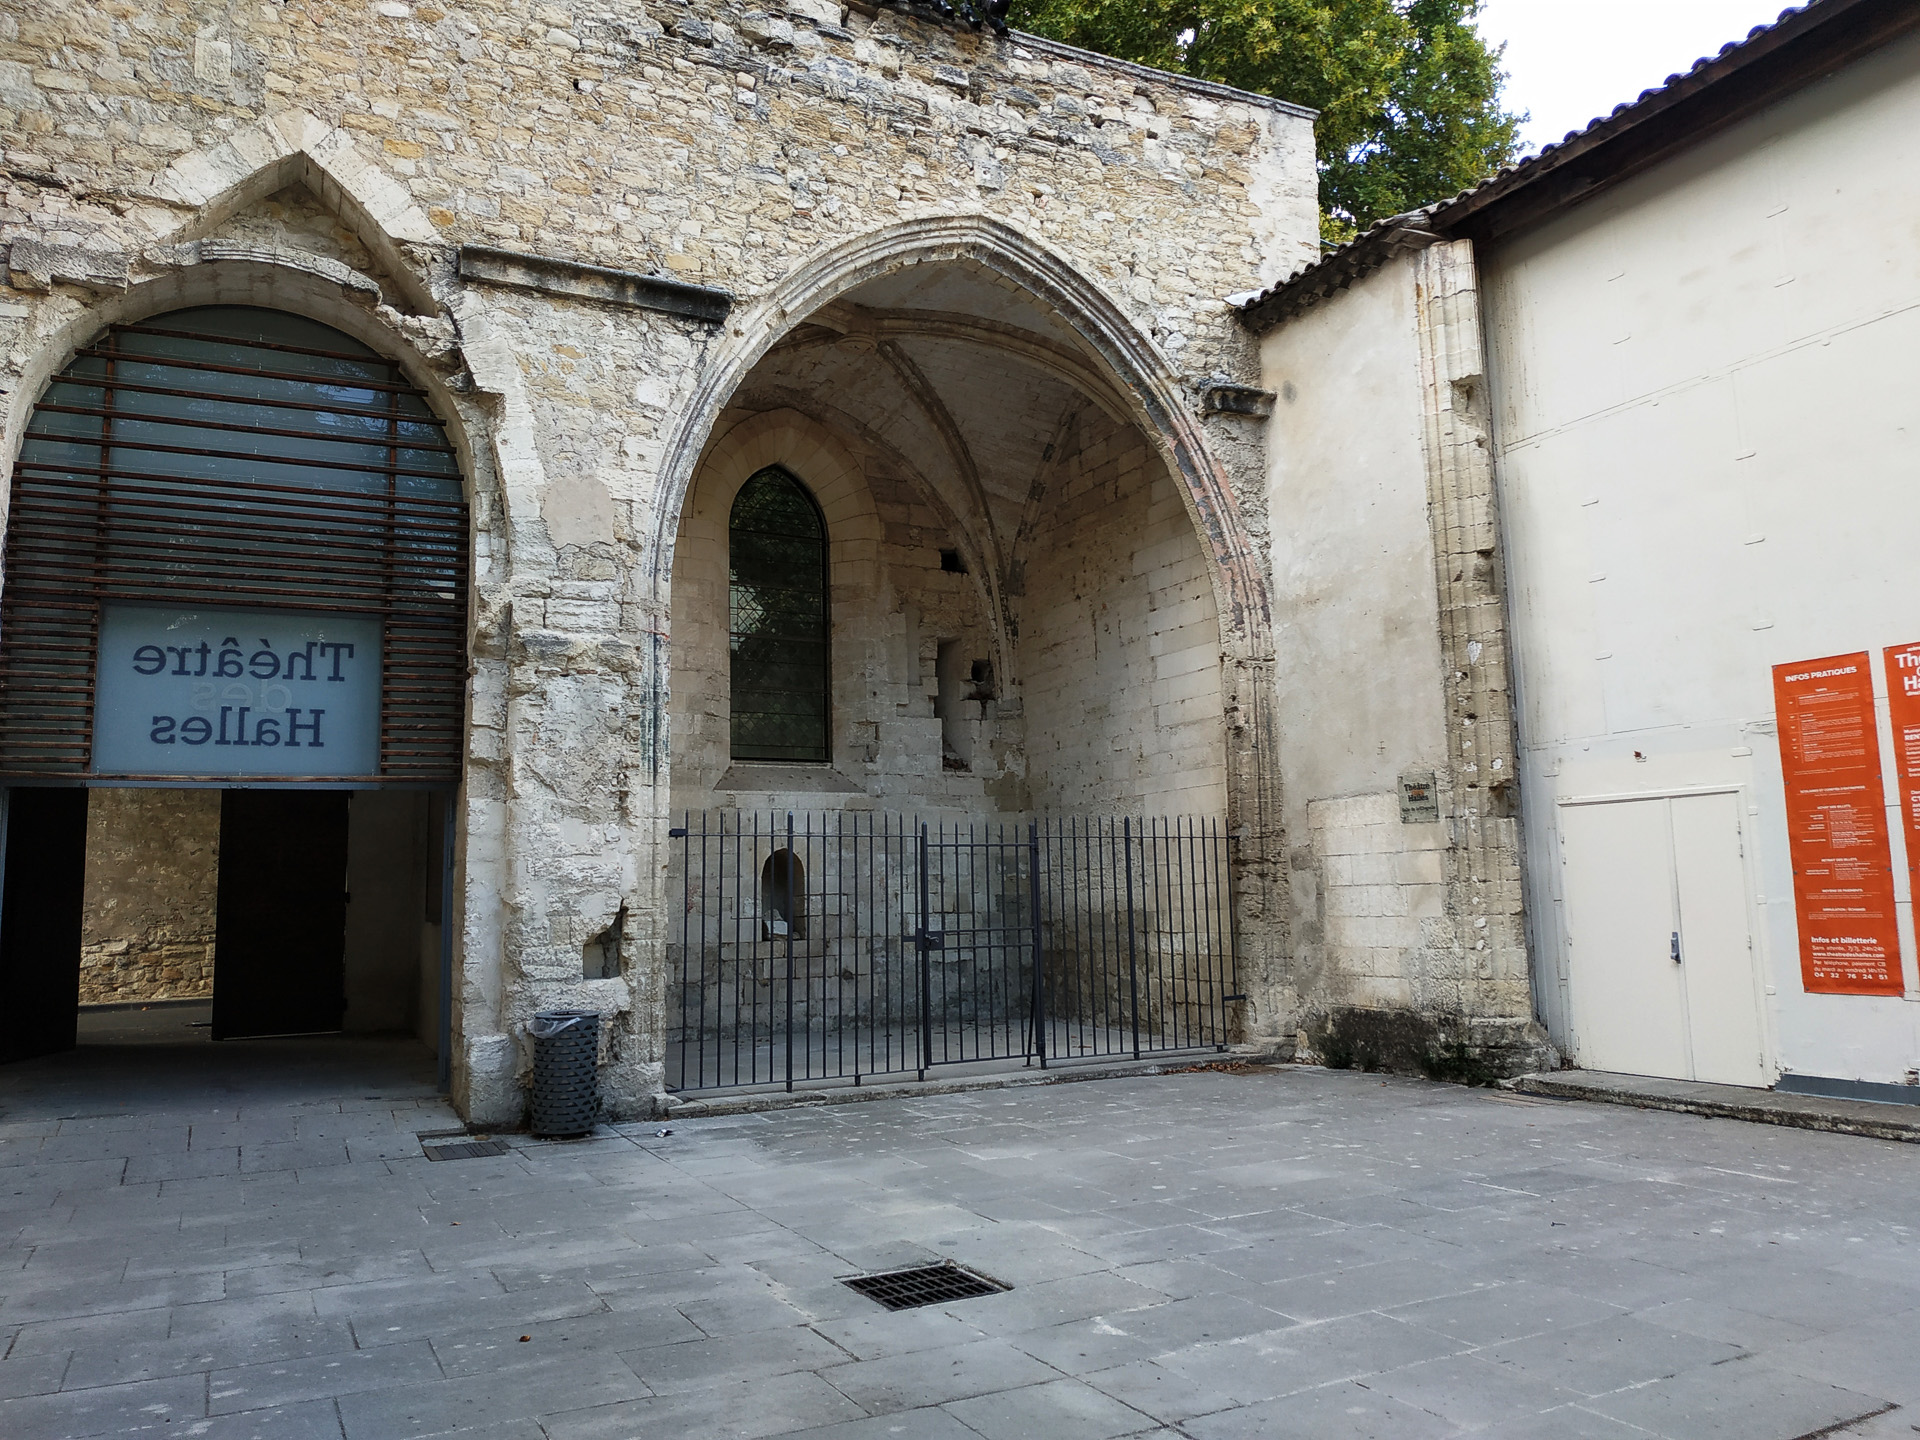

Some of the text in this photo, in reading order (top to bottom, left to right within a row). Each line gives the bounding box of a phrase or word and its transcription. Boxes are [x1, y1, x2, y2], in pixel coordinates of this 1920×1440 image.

[1894, 653, 1920, 668] Th
[1785, 666, 1857, 682] INFOS PRATIQUES
